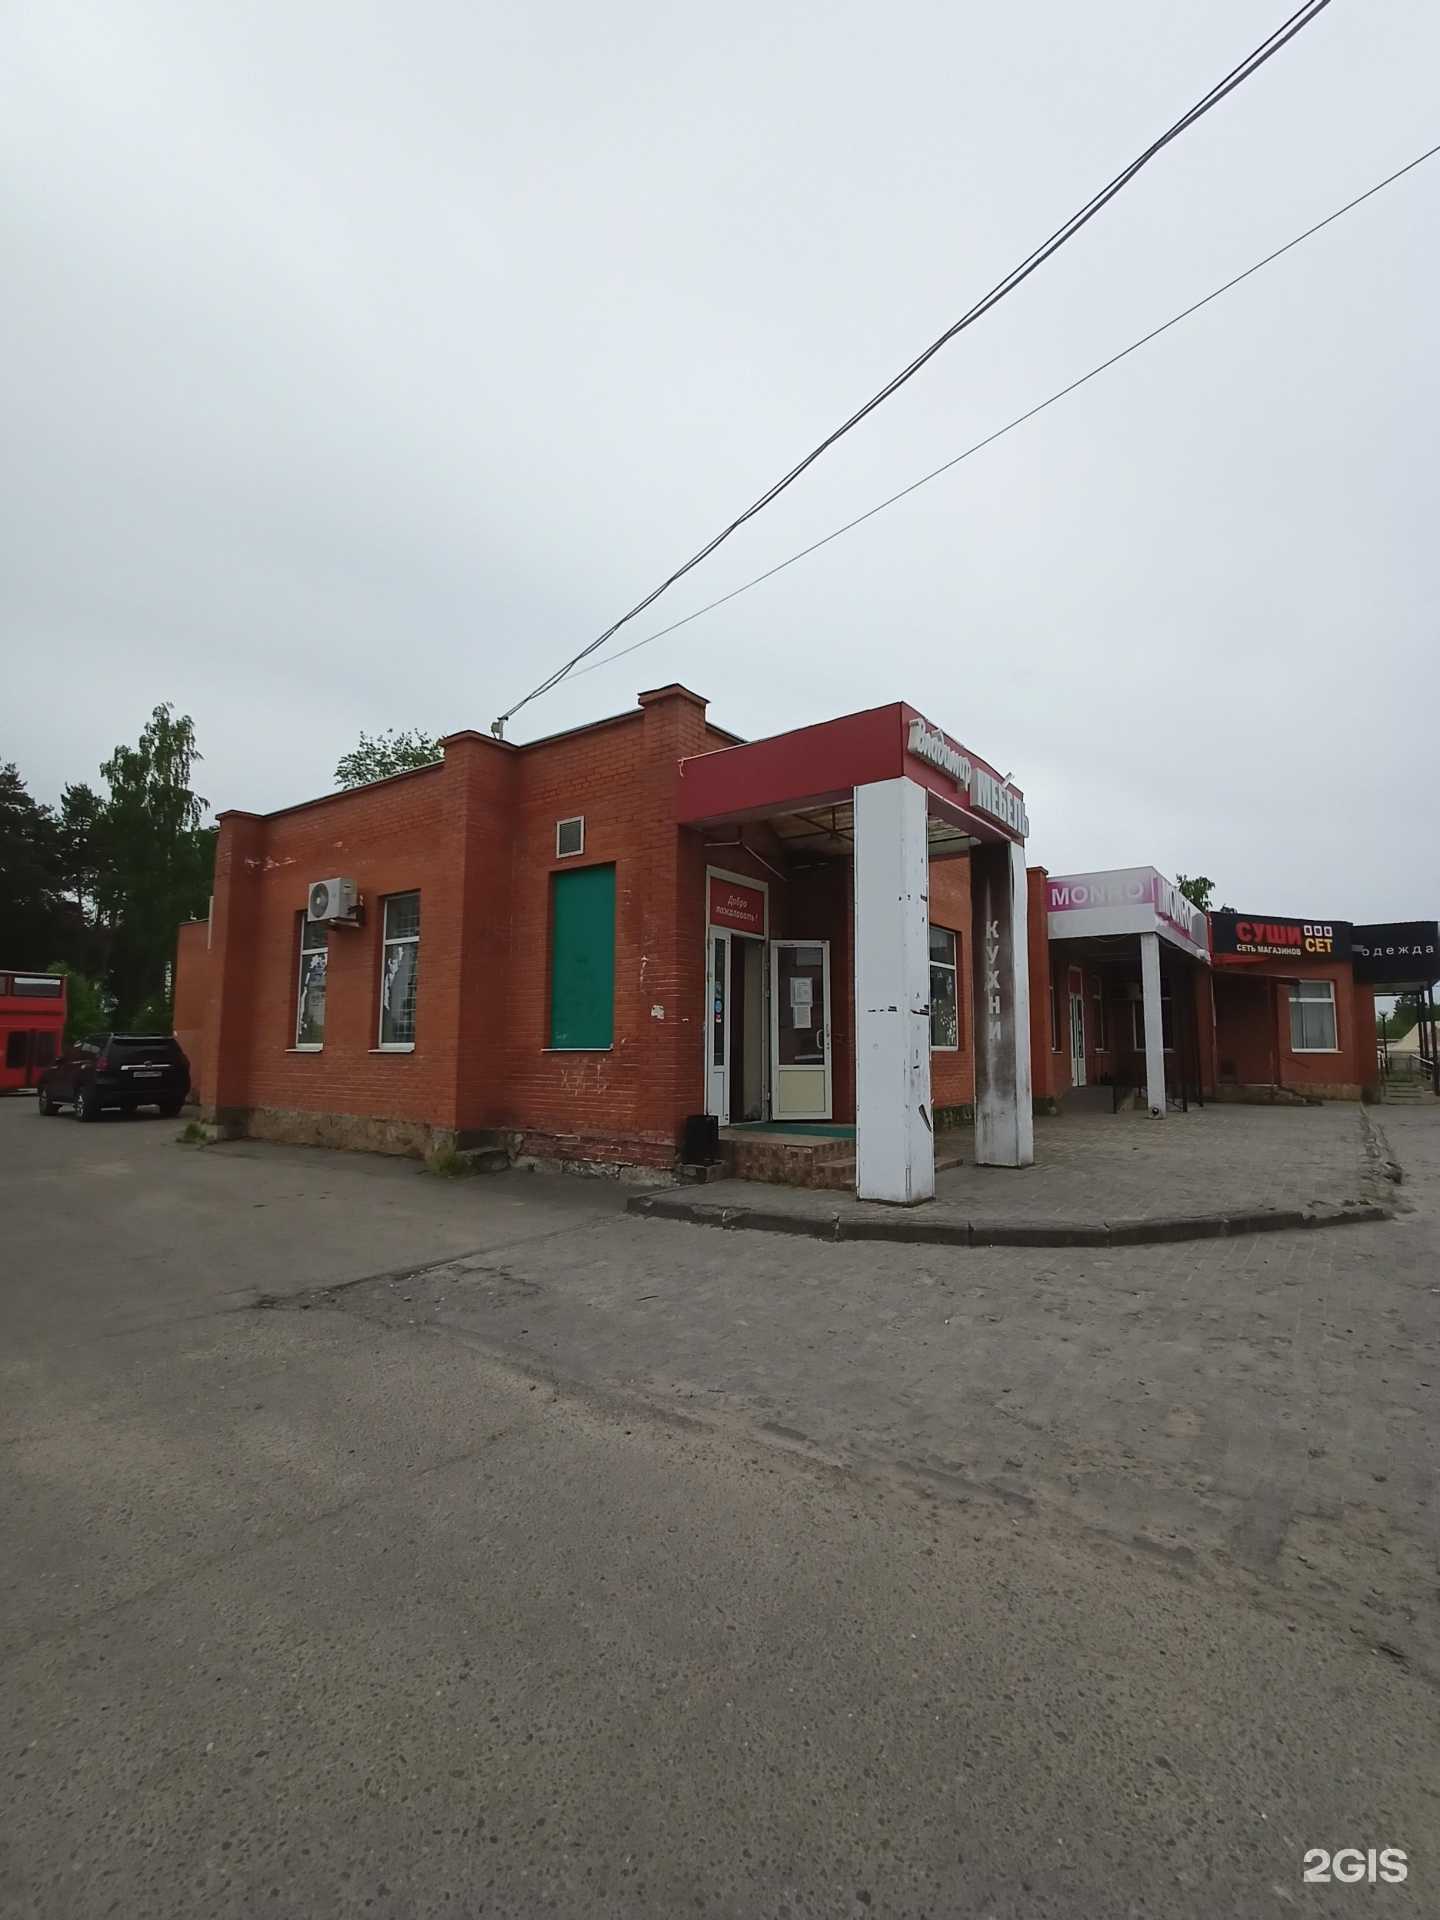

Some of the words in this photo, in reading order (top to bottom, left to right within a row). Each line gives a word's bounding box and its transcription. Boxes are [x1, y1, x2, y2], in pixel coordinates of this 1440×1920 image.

[970, 767, 1029, 838] МЕБЕЛЬ
[727, 895, 748, 908] Добро
[1051, 880, 1144, 906] MONO
[1235, 922, 1302, 945] СУШИ
[1236, 943, 1257, 953] СЕТЬ
[1257, 945, 1302, 956] МАГАЗИНОВ
[1361, 944, 1434, 957] одежда
[1305, 938, 1333, 953] СЕТ
[985, 920, 1002, 1041] КУХНИ
